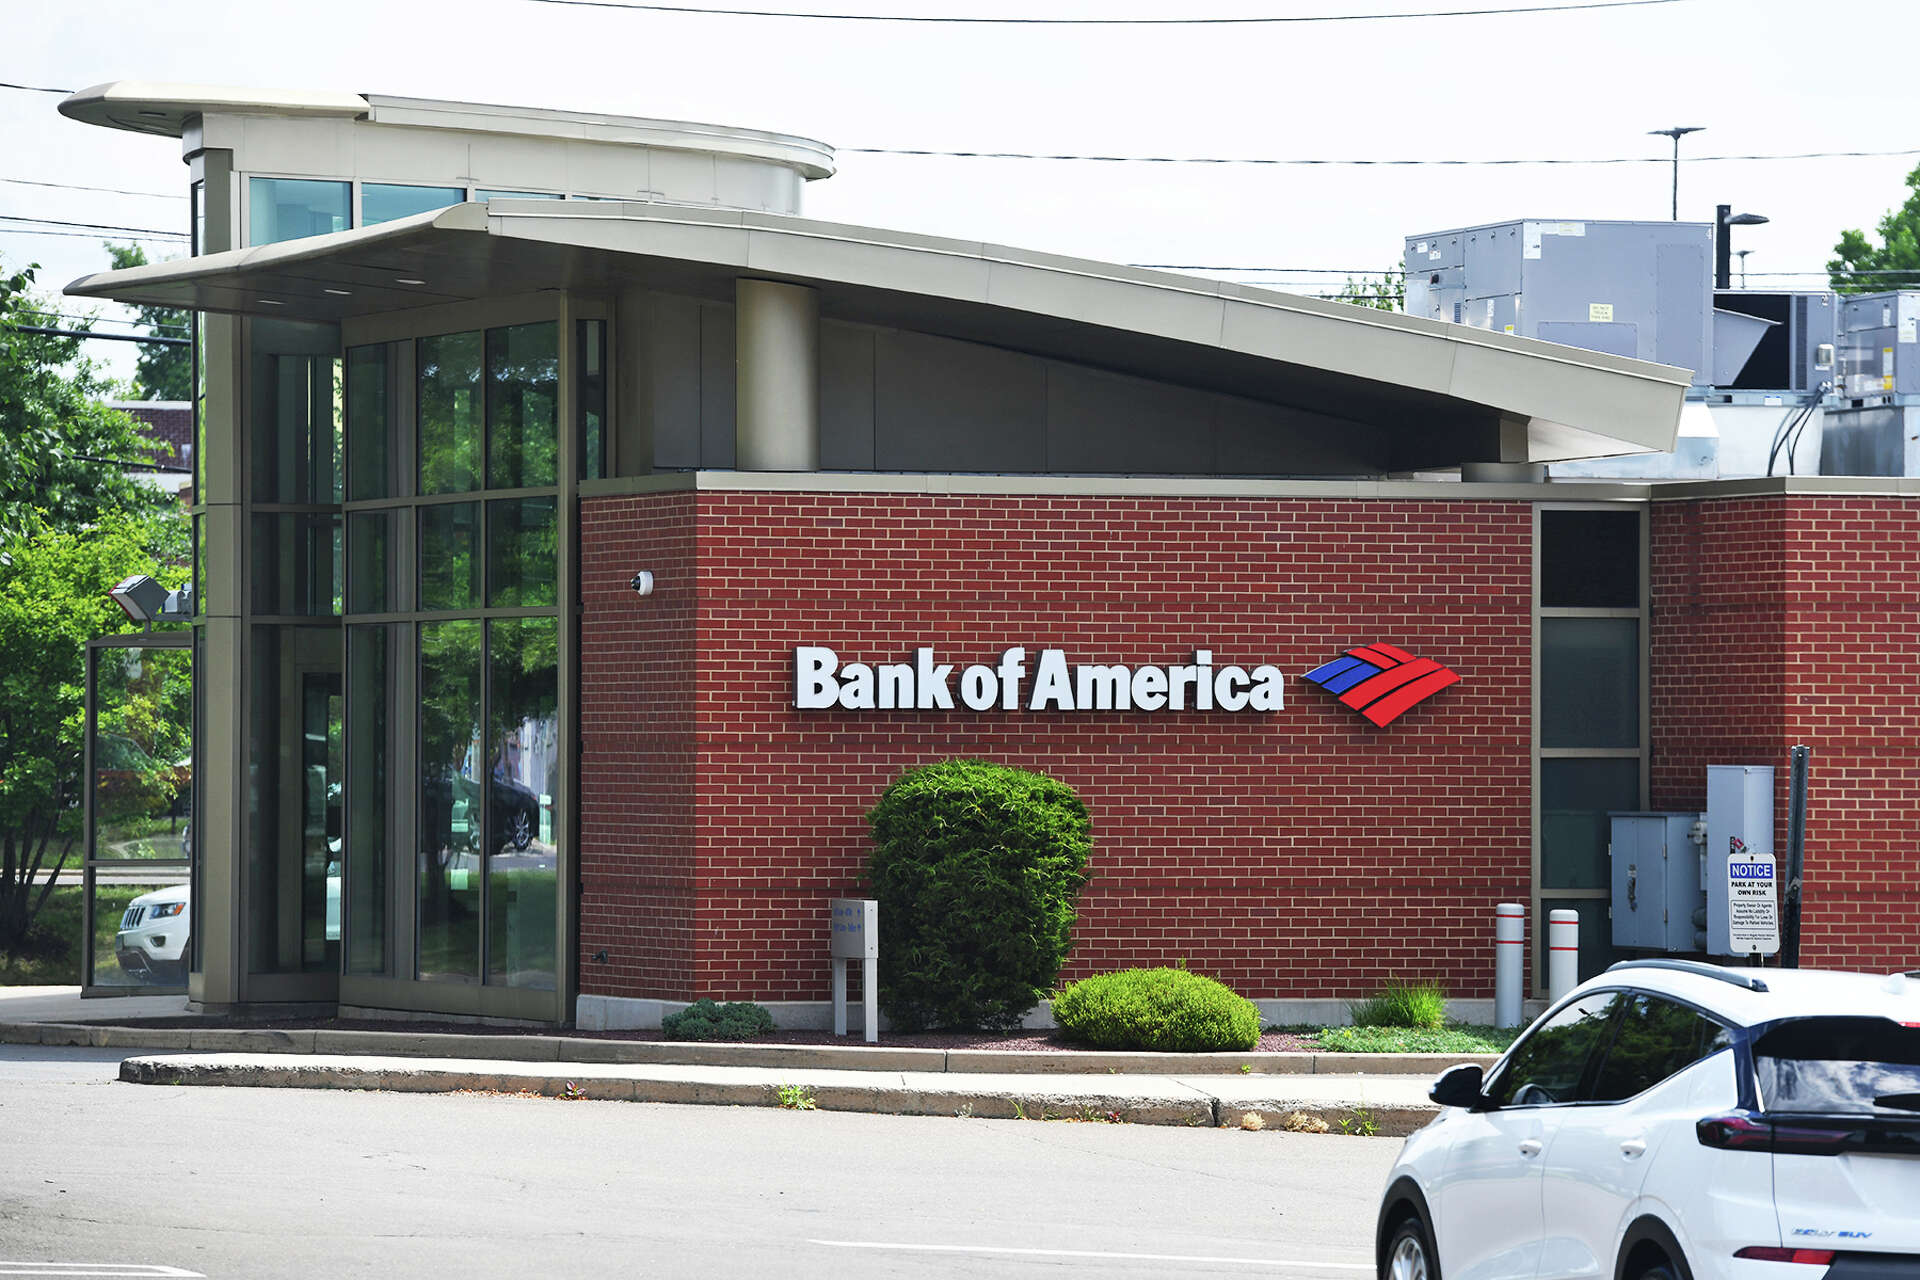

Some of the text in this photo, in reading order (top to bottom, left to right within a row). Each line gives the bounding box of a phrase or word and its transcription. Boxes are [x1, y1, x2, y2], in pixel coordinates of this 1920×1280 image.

[795, 645, 1285, 712] Bank of America
[1732, 864, 1771, 877] NOTICE
